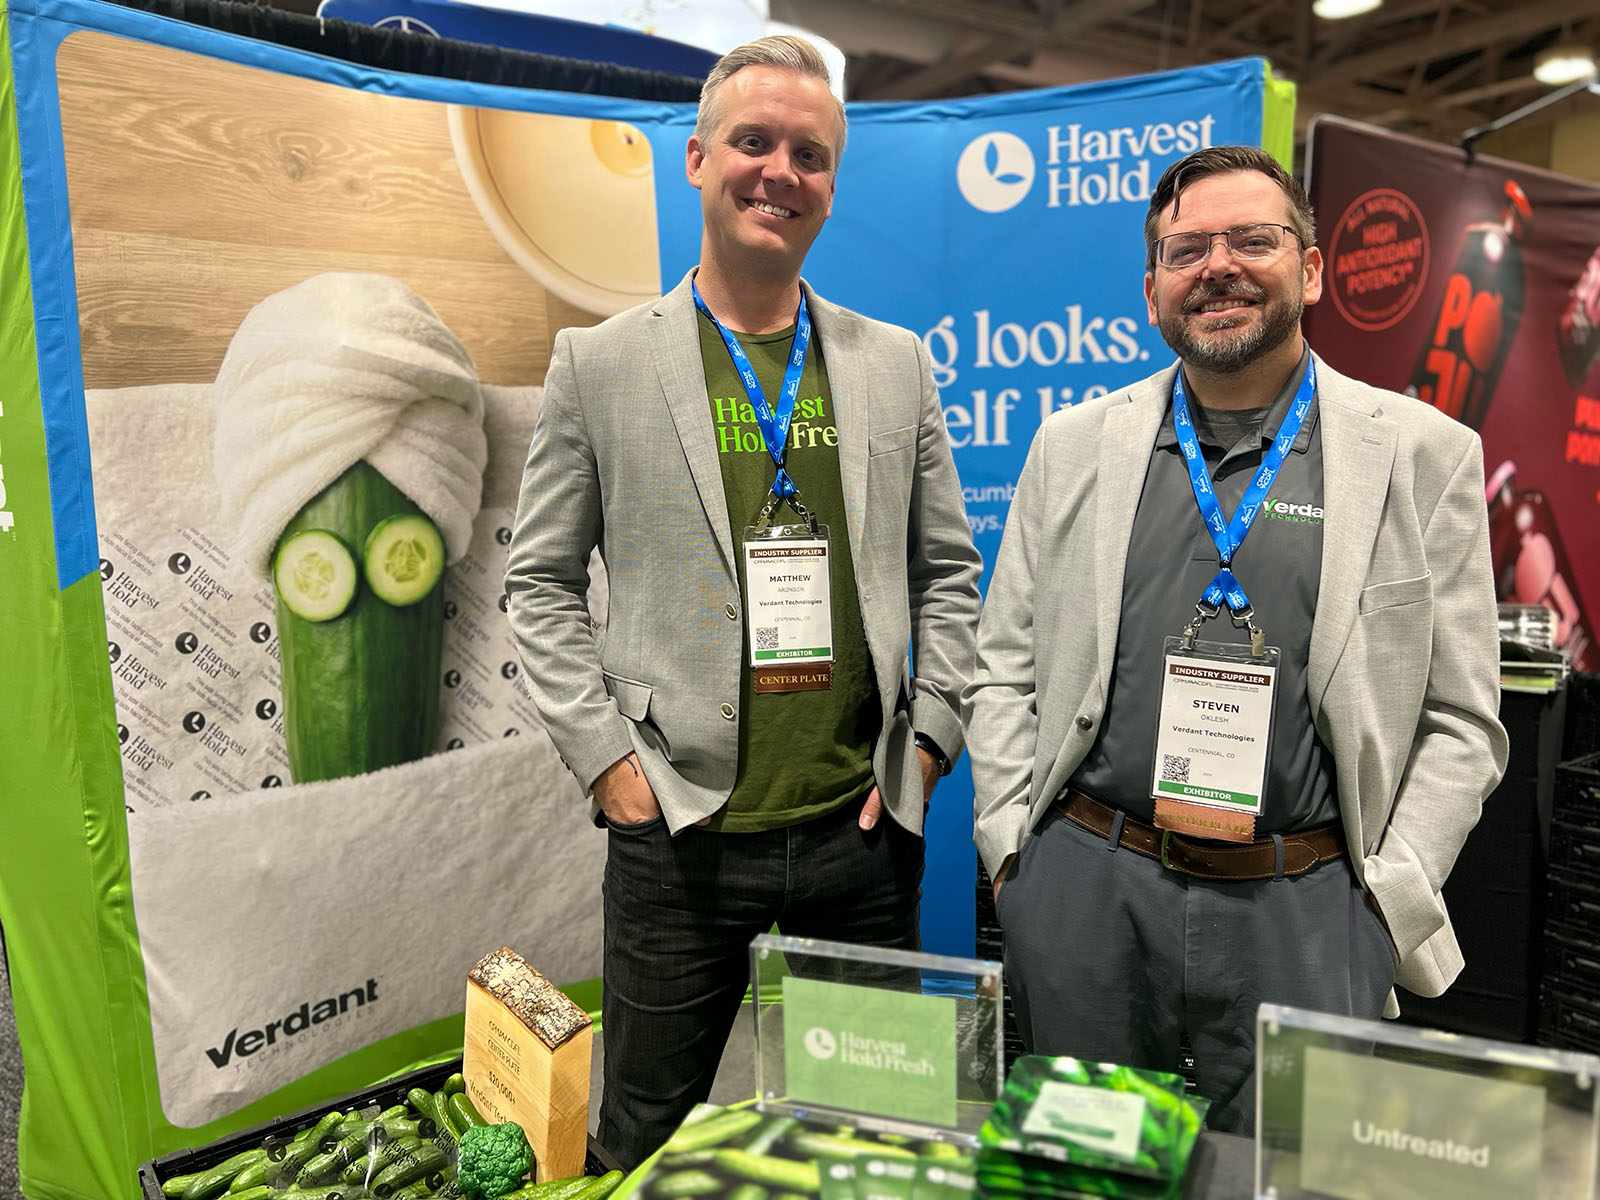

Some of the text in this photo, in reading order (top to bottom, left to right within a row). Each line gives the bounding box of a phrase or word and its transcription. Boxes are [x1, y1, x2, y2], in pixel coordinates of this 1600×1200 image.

[1047, 114, 1215, 164] Harvest
[1047, 160, 1153, 207] Hold
[974, 304, 1150, 368] looks.
[107, 582, 138, 608] Hold
[116, 571, 160, 609] Harvest
[185, 575, 214, 600] Hold
[193, 565, 234, 601] Harvest
[123, 654, 168, 690] Harvest
[192, 654, 221, 679] Hold
[200, 644, 241, 679] Harvest
[1175, 667, 1265, 684] INDUSTRY SUPPLIER
[115, 663, 146, 690] Hold
[759, 673, 828, 684] CENTER PLATE
[1192, 700, 1240, 713] STEVEN
[1200, 714, 1229, 723] OKLESH
[200, 732, 228, 757] Hold
[207, 722, 248, 756] Harvest
[1172, 725, 1255, 743] Verdant Technologies
[122, 746, 153, 771] Hold
[131, 735, 174, 770] Harvest
[1183, 786, 1232, 800] EXHIBITOR
[205, 978, 378, 1069] Verdant
[840, 1030, 907, 1056] Harvest
[488, 1040, 520, 1076] CENTER PLATE
[470, 1079, 492, 1112] Verdant
[382, 1145, 405, 1167] Hold
[388, 1138, 420, 1167] Harvest
[1352, 1120, 1490, 1167] Untreated
